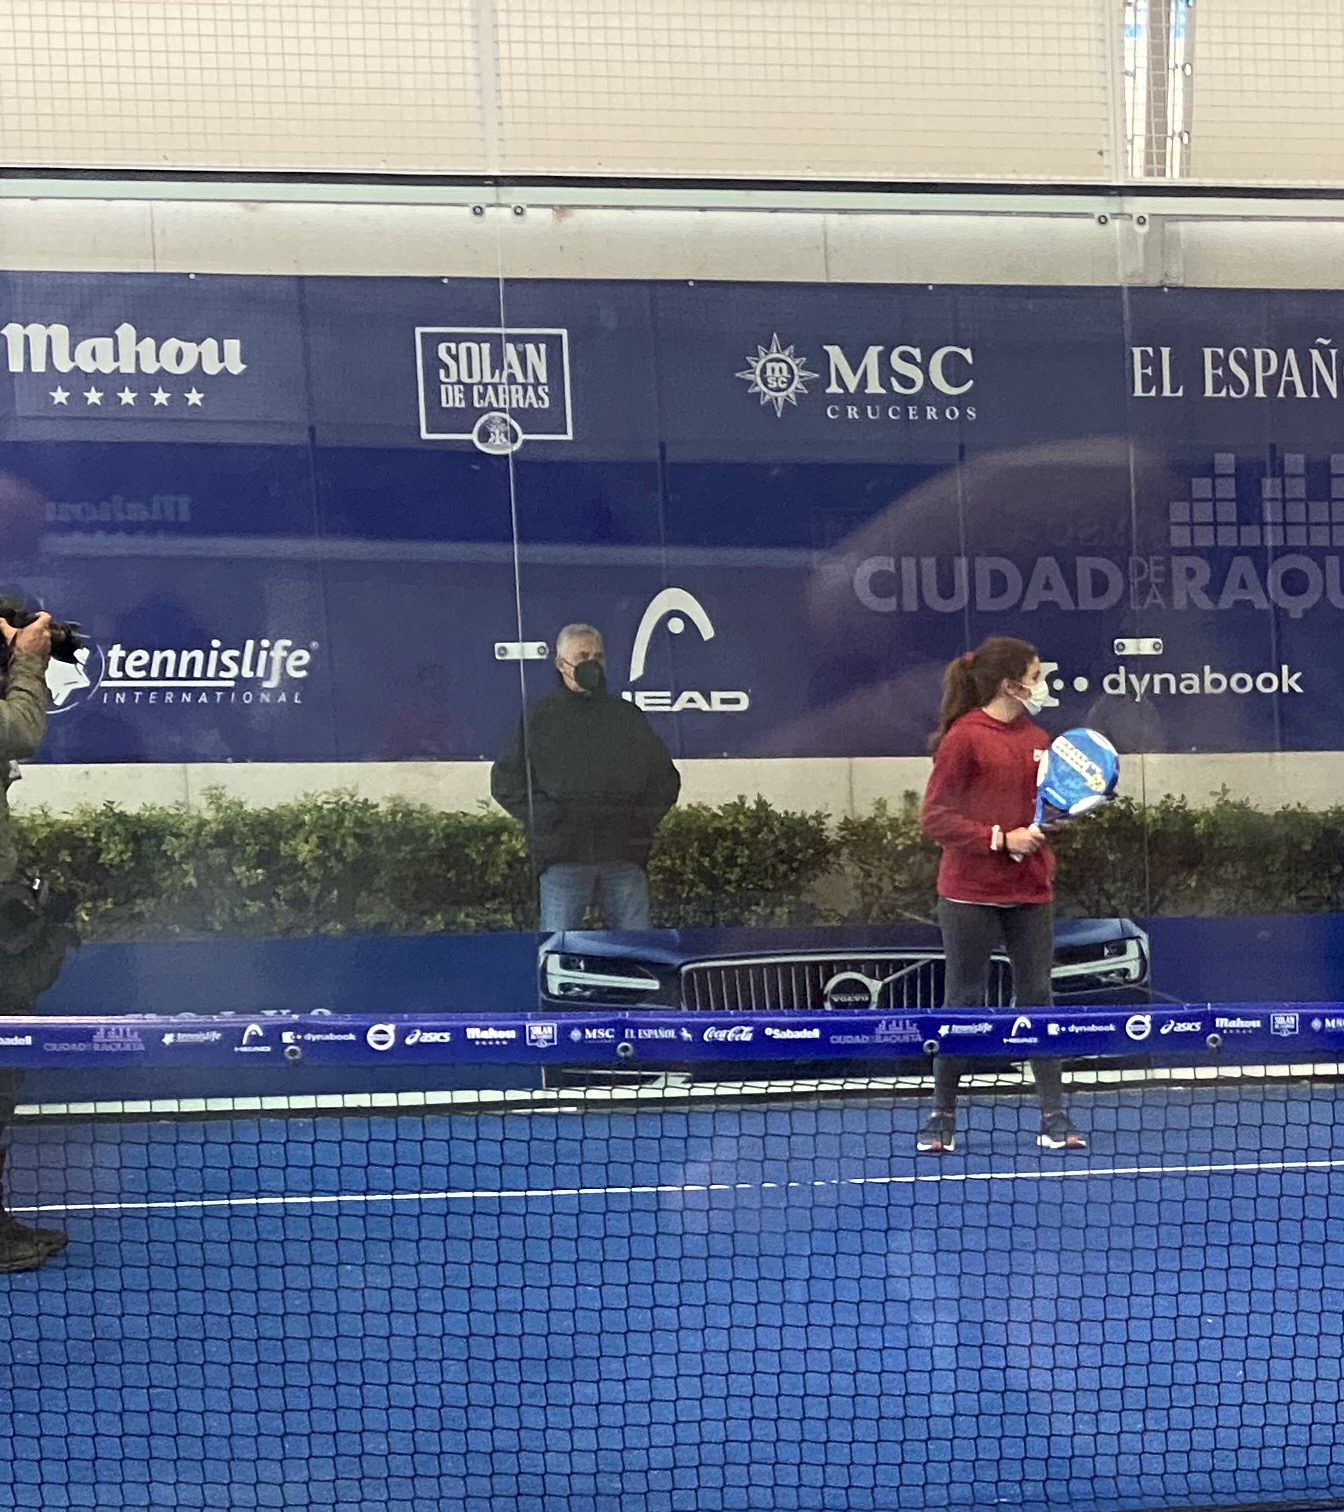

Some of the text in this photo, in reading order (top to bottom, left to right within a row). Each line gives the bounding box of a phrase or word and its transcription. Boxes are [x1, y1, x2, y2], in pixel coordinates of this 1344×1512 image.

[2, 322, 247, 376] Mahou
[437, 342, 548, 384] SOLAN
[823, 345, 975, 395] MSC
[1131, 346, 1184, 398] EL
[440, 384, 550, 409] DE CABRAS
[826, 404, 977, 421] CRUCEROS
[853, 556, 1126, 612] CIUDAD
[107, 639, 311, 688] tennislife
[1103, 664, 1305, 702] dynabook
[103, 691, 302, 705] INTERNATIONAL
[1068, 1023, 1116, 1034] dynabook
[1215, 1018, 1262, 1029] Mahou
[304, 1032, 357, 1043] dynabook
[466, 1028, 517, 1040] Mahou
[584, 1028, 616, 1039] MSC
[624, 1027, 677, 1039] EL ESPAÑOL
[703, 1025, 755, 1042] Coca-Cola
[772, 1028, 820, 1040] Sabadell
